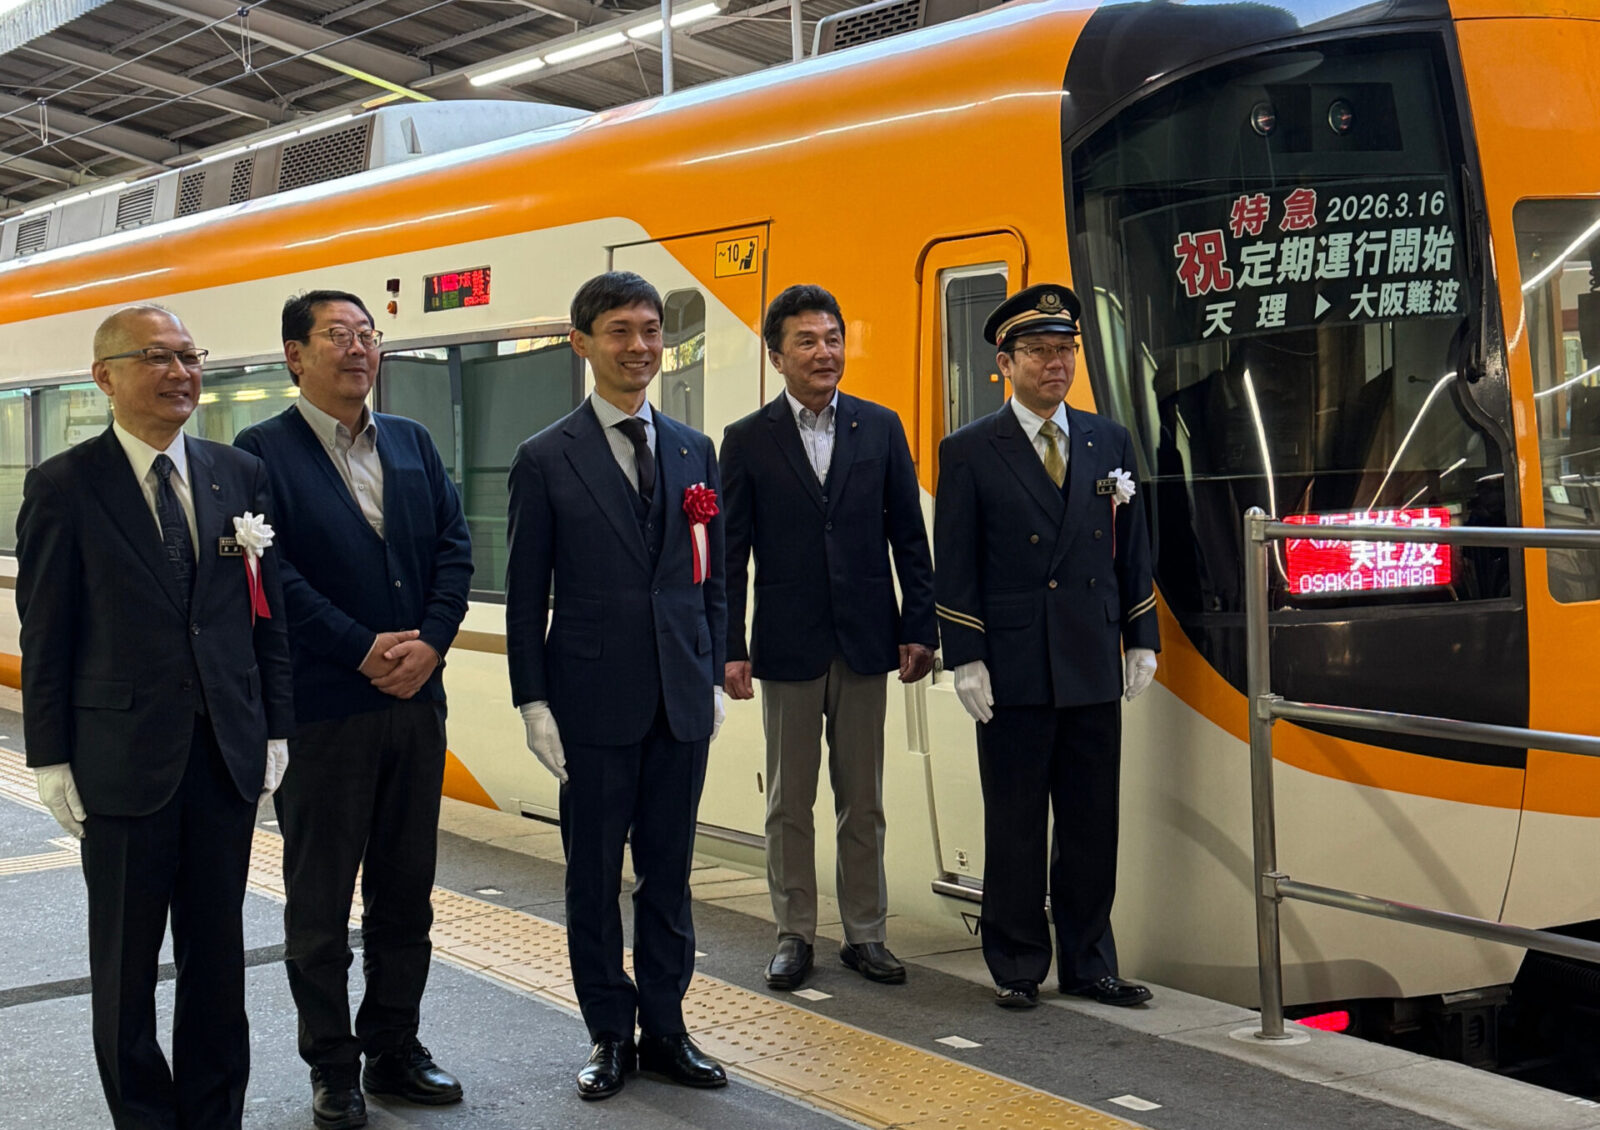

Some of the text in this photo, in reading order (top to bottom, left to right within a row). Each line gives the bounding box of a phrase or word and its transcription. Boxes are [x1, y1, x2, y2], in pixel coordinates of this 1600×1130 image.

[1229, 188, 1446, 239] 特急 2026.3.16
[1173, 229, 1234, 298] 祝
[1236, 225, 1456, 290] 定期運行開始
[1202, 278, 1461, 338] 天理 大阪難波
[1299, 567, 1436, 594] OSAKA-NAMBA
